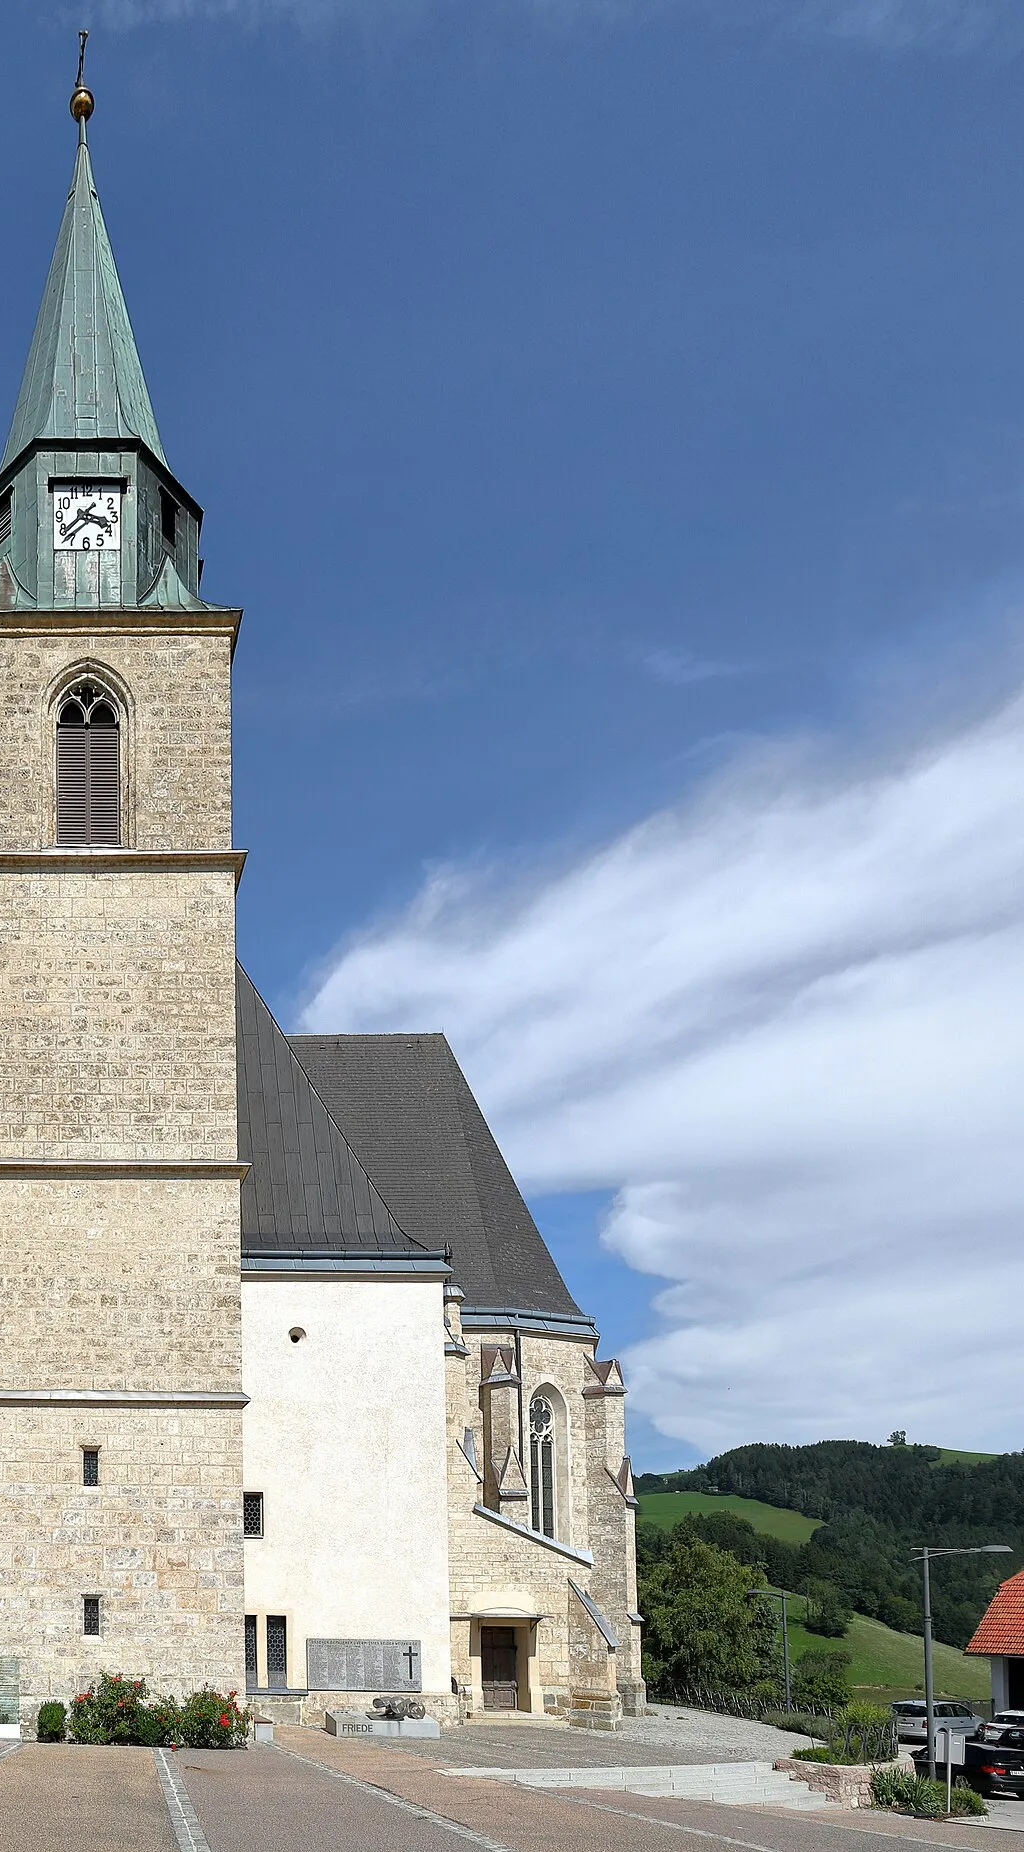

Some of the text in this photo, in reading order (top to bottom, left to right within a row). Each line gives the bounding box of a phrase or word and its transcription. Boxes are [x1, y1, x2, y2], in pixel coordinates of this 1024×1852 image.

[70, 486, 78, 499] 11
[82, 484, 92, 497] 12
[98, 487, 102, 500] 1
[58, 497, 70, 509] 10
[107, 498, 114, 510] 2
[56, 511, 63, 522] 9
[110, 511, 118, 523] 3
[59, 523, 66, 536] 8
[105, 524, 112, 536] 4
[69, 533, 75, 546] 7
[83, 537, 90, 550] 6
[96, 534, 104, 546] 5
[342, 1723, 373, 1732] FRIEDE
